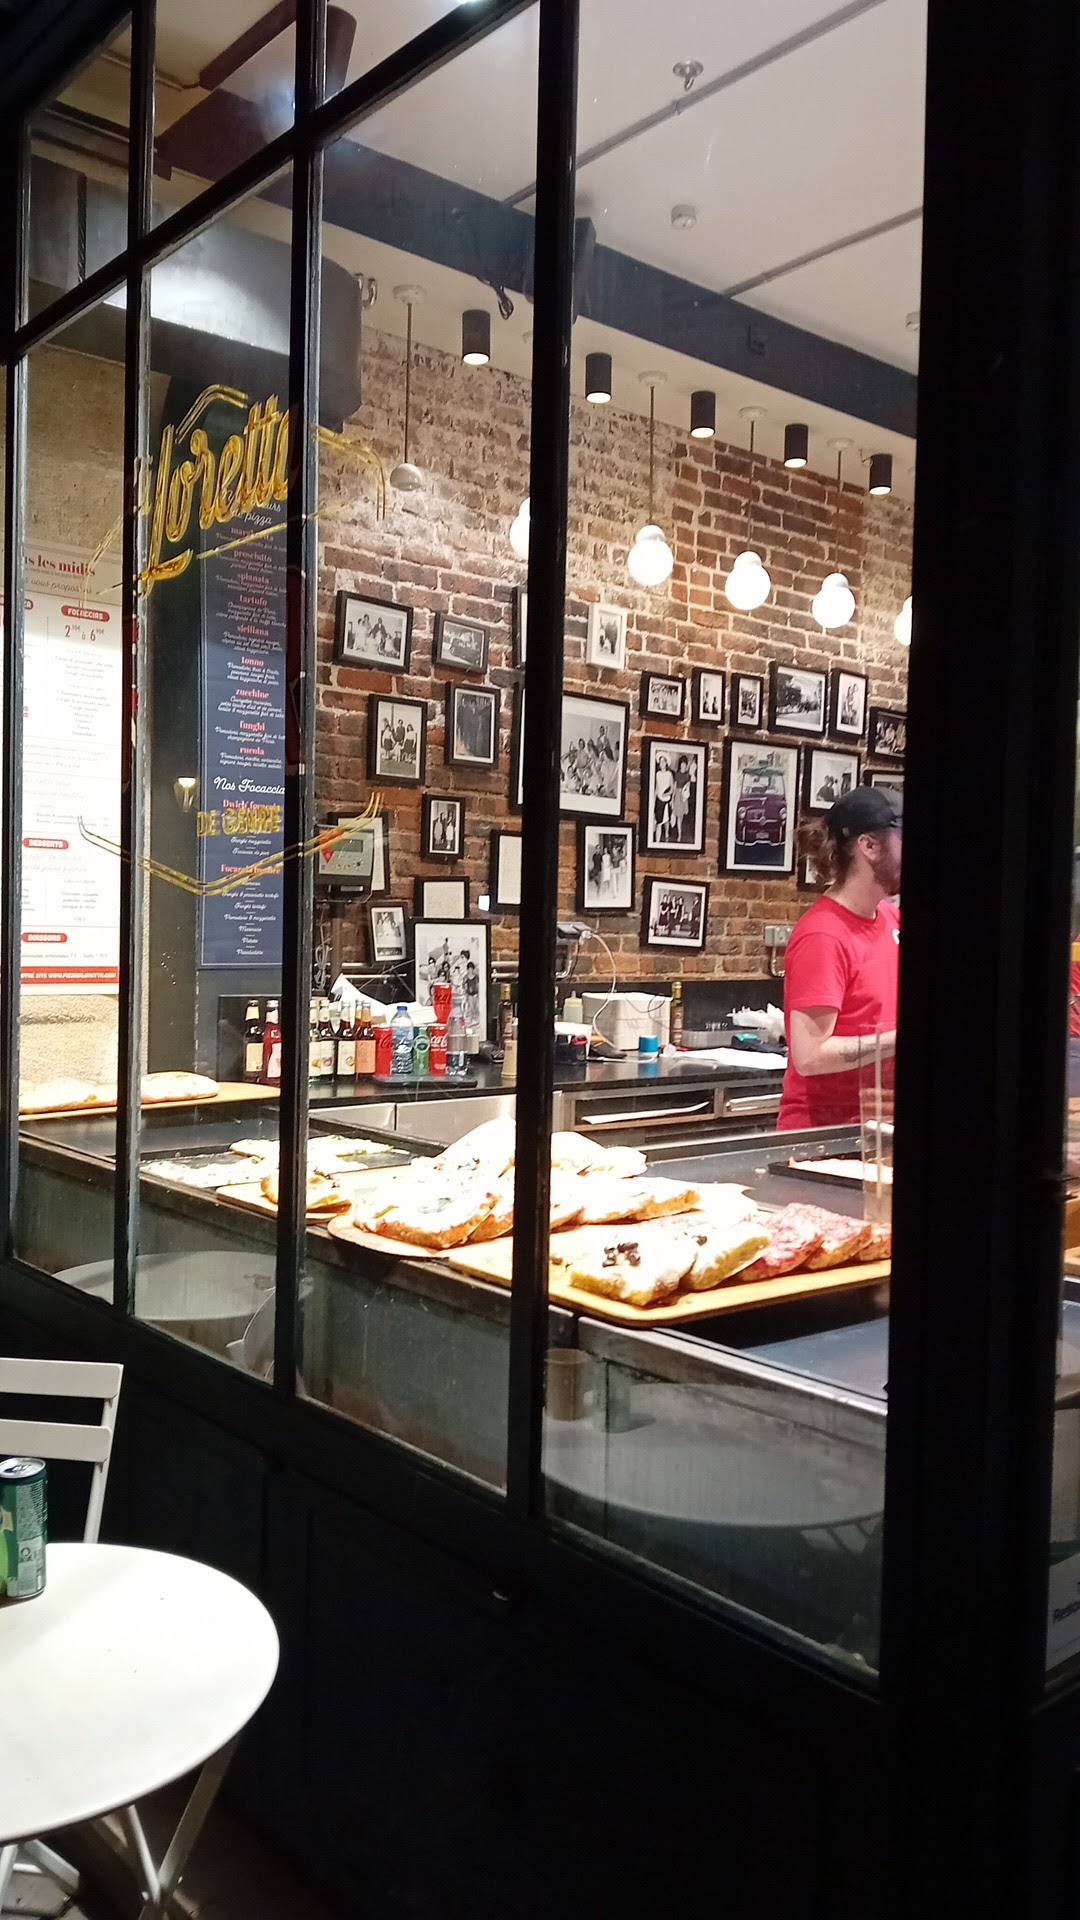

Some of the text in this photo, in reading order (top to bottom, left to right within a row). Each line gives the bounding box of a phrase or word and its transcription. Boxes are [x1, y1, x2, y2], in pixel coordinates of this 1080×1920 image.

[244, 513, 272, 526] pizza
[38, 555, 56, 568] les
[240, 594, 267, 606] tartufo
[241, 656, 264, 666] tonno
[236, 688, 270, 699] zucchine
[240, 720, 265, 732] funghi
[214, 776, 285, 794] Nos Focaccia
[197, 810, 218, 838] DE
